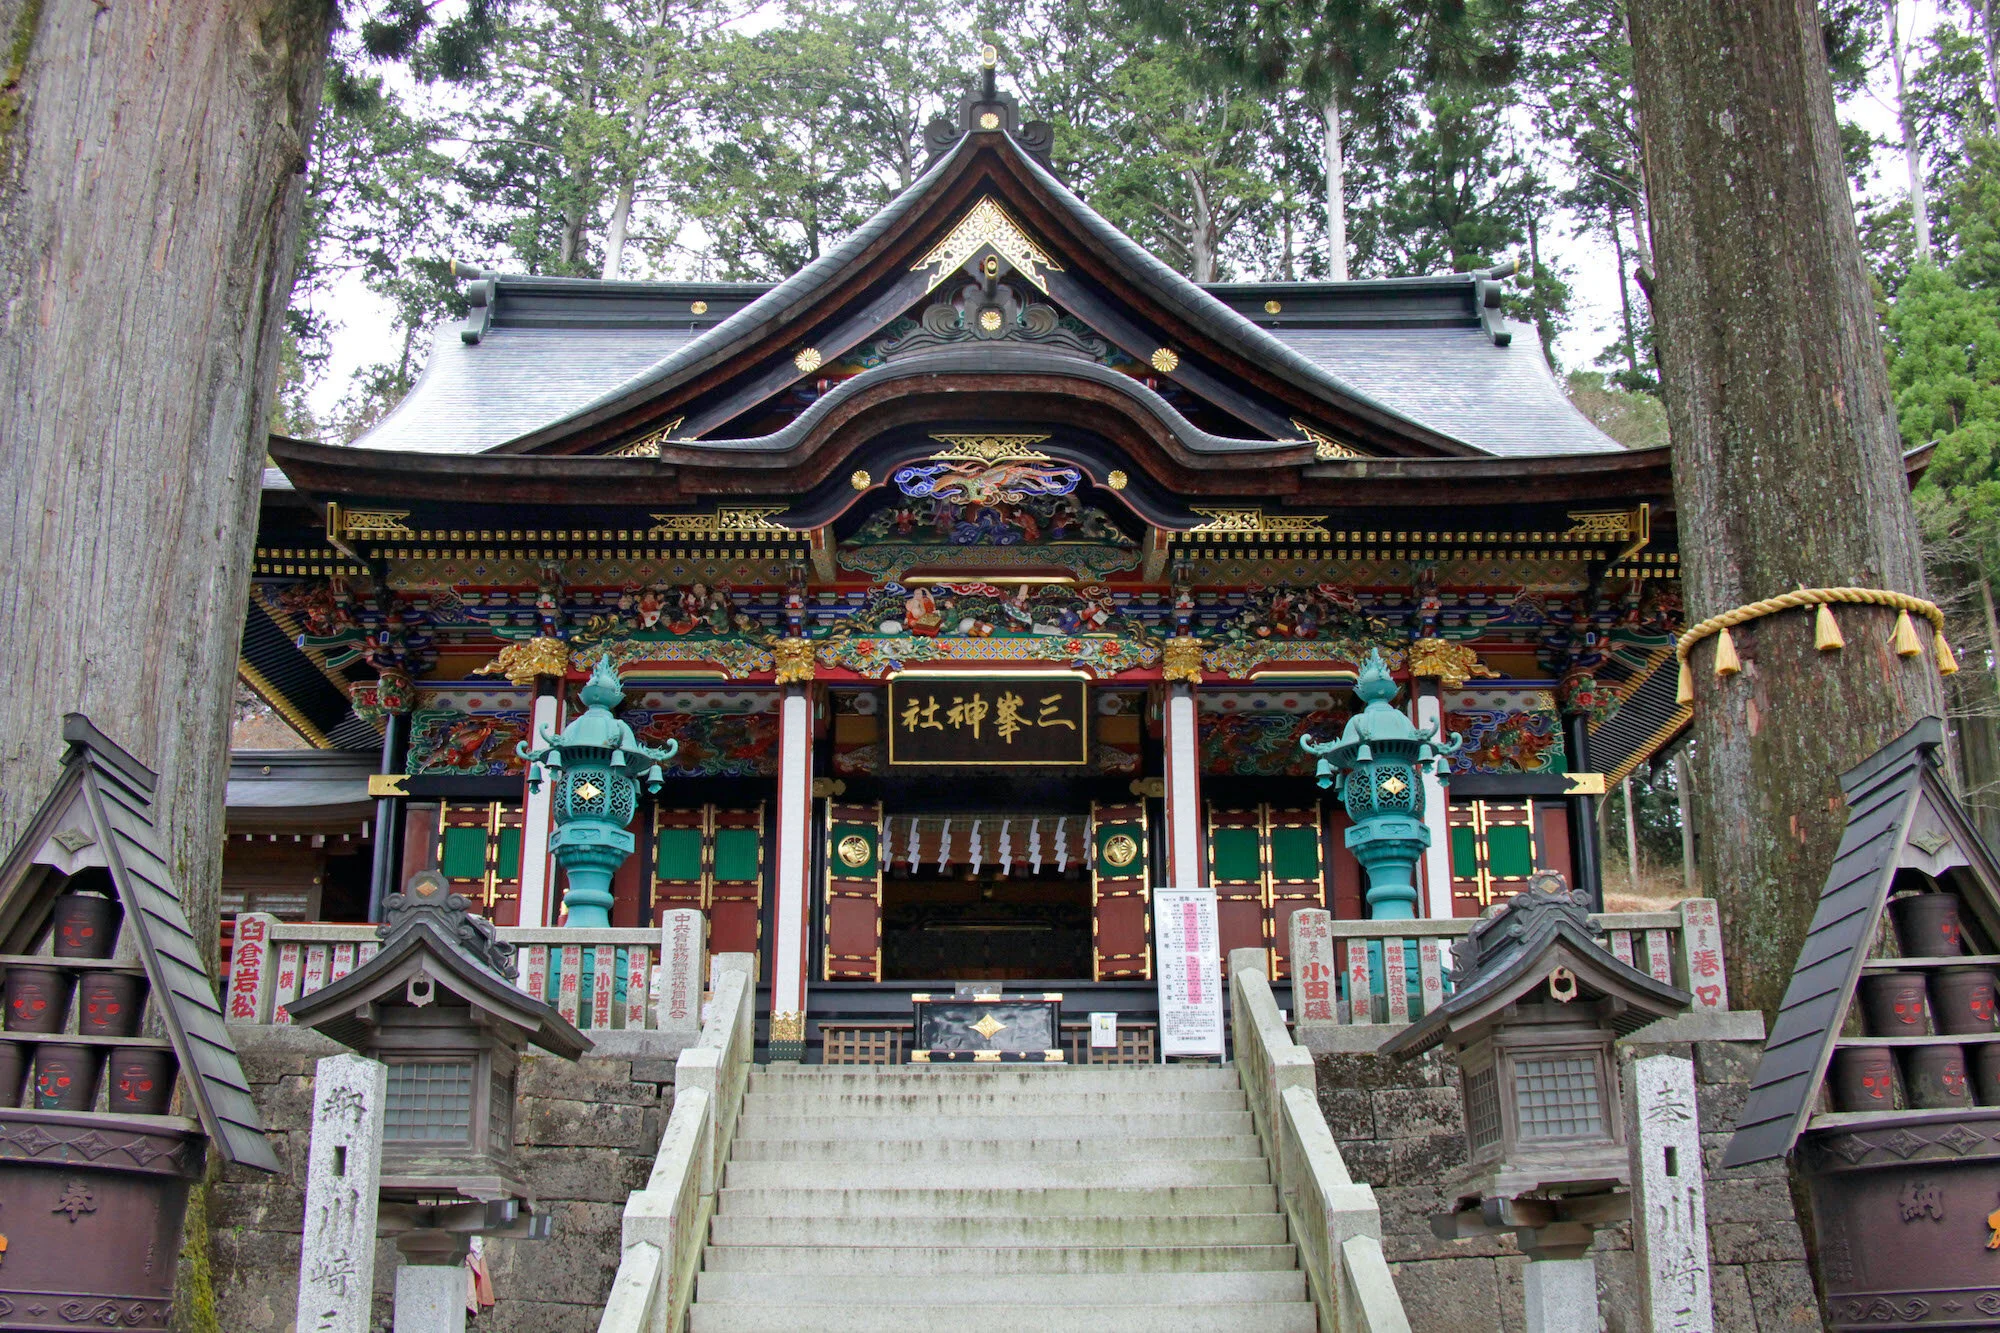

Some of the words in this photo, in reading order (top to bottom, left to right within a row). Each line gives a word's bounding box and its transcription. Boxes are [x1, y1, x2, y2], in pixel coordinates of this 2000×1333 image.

[1302, 962, 1332, 1020] 小田磯
[1646, 1081, 1692, 1126] 奉
[52, 1179, 97, 1224] 奉
